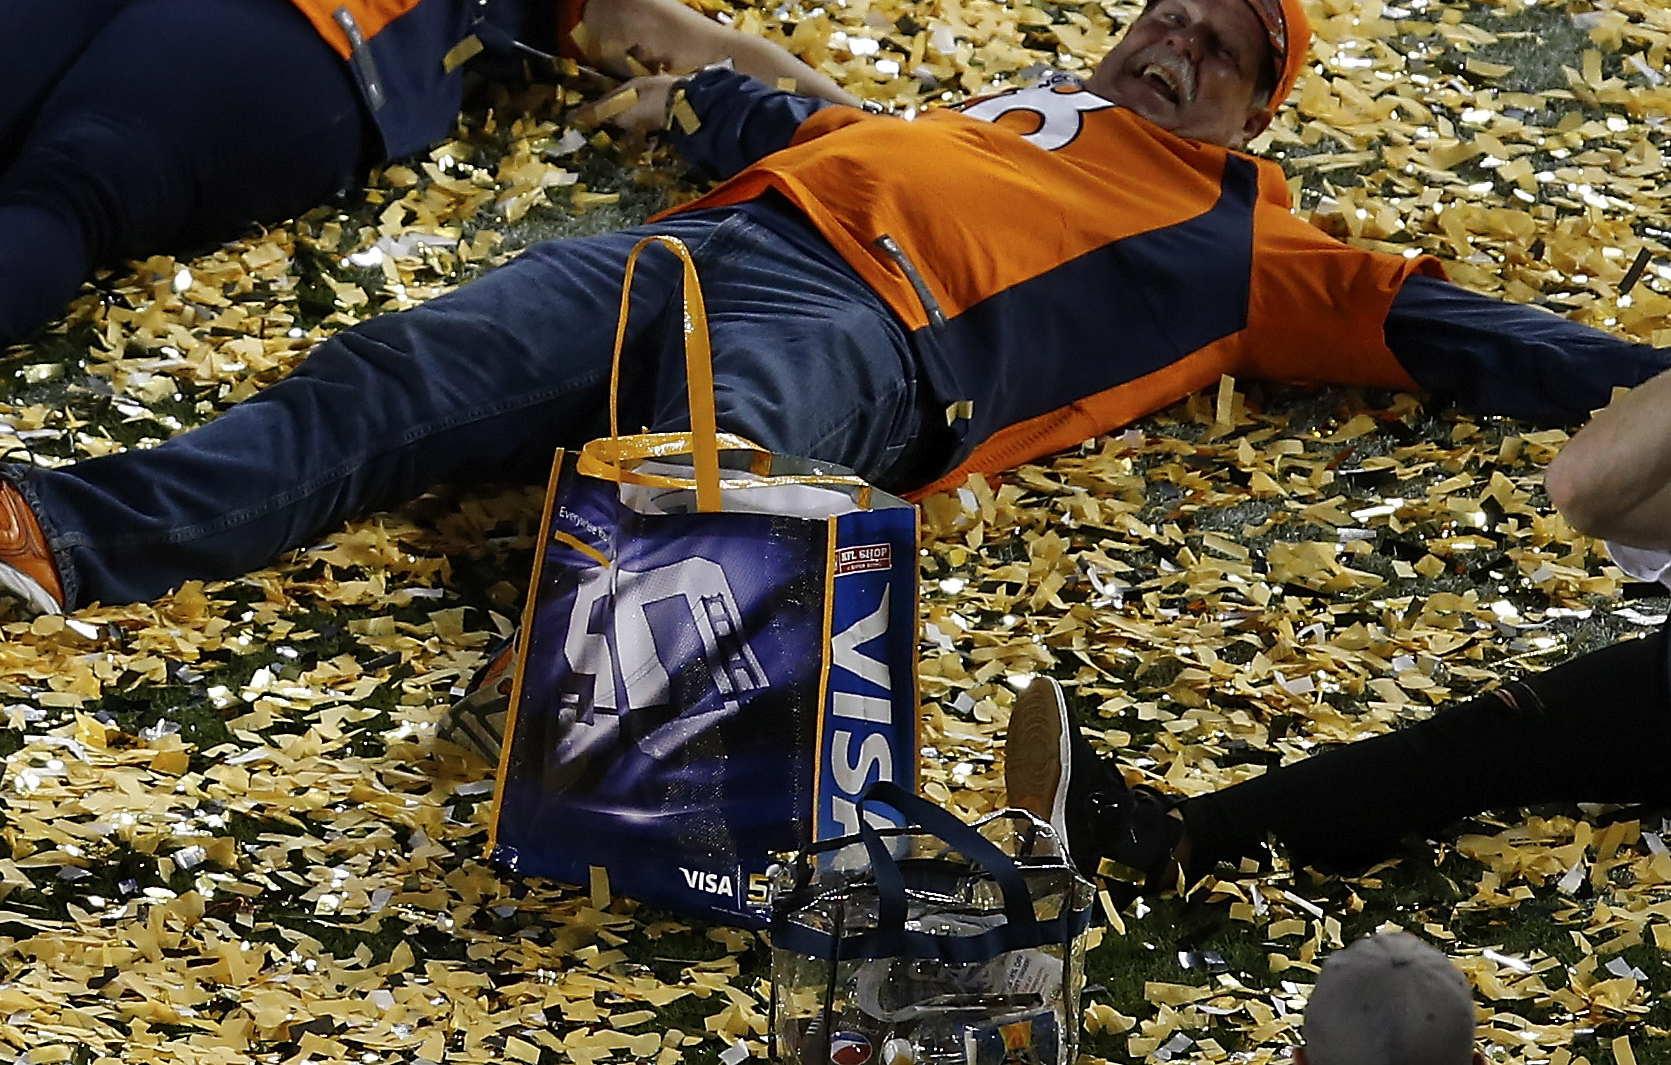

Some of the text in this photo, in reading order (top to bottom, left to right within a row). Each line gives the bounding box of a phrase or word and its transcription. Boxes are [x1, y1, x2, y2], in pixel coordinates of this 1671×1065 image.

[841, 550, 857, 562] NFL
[858, 547, 888, 559] SHOP
[831, 582, 899, 872] VISA
[678, 866, 733, 897] VISA
